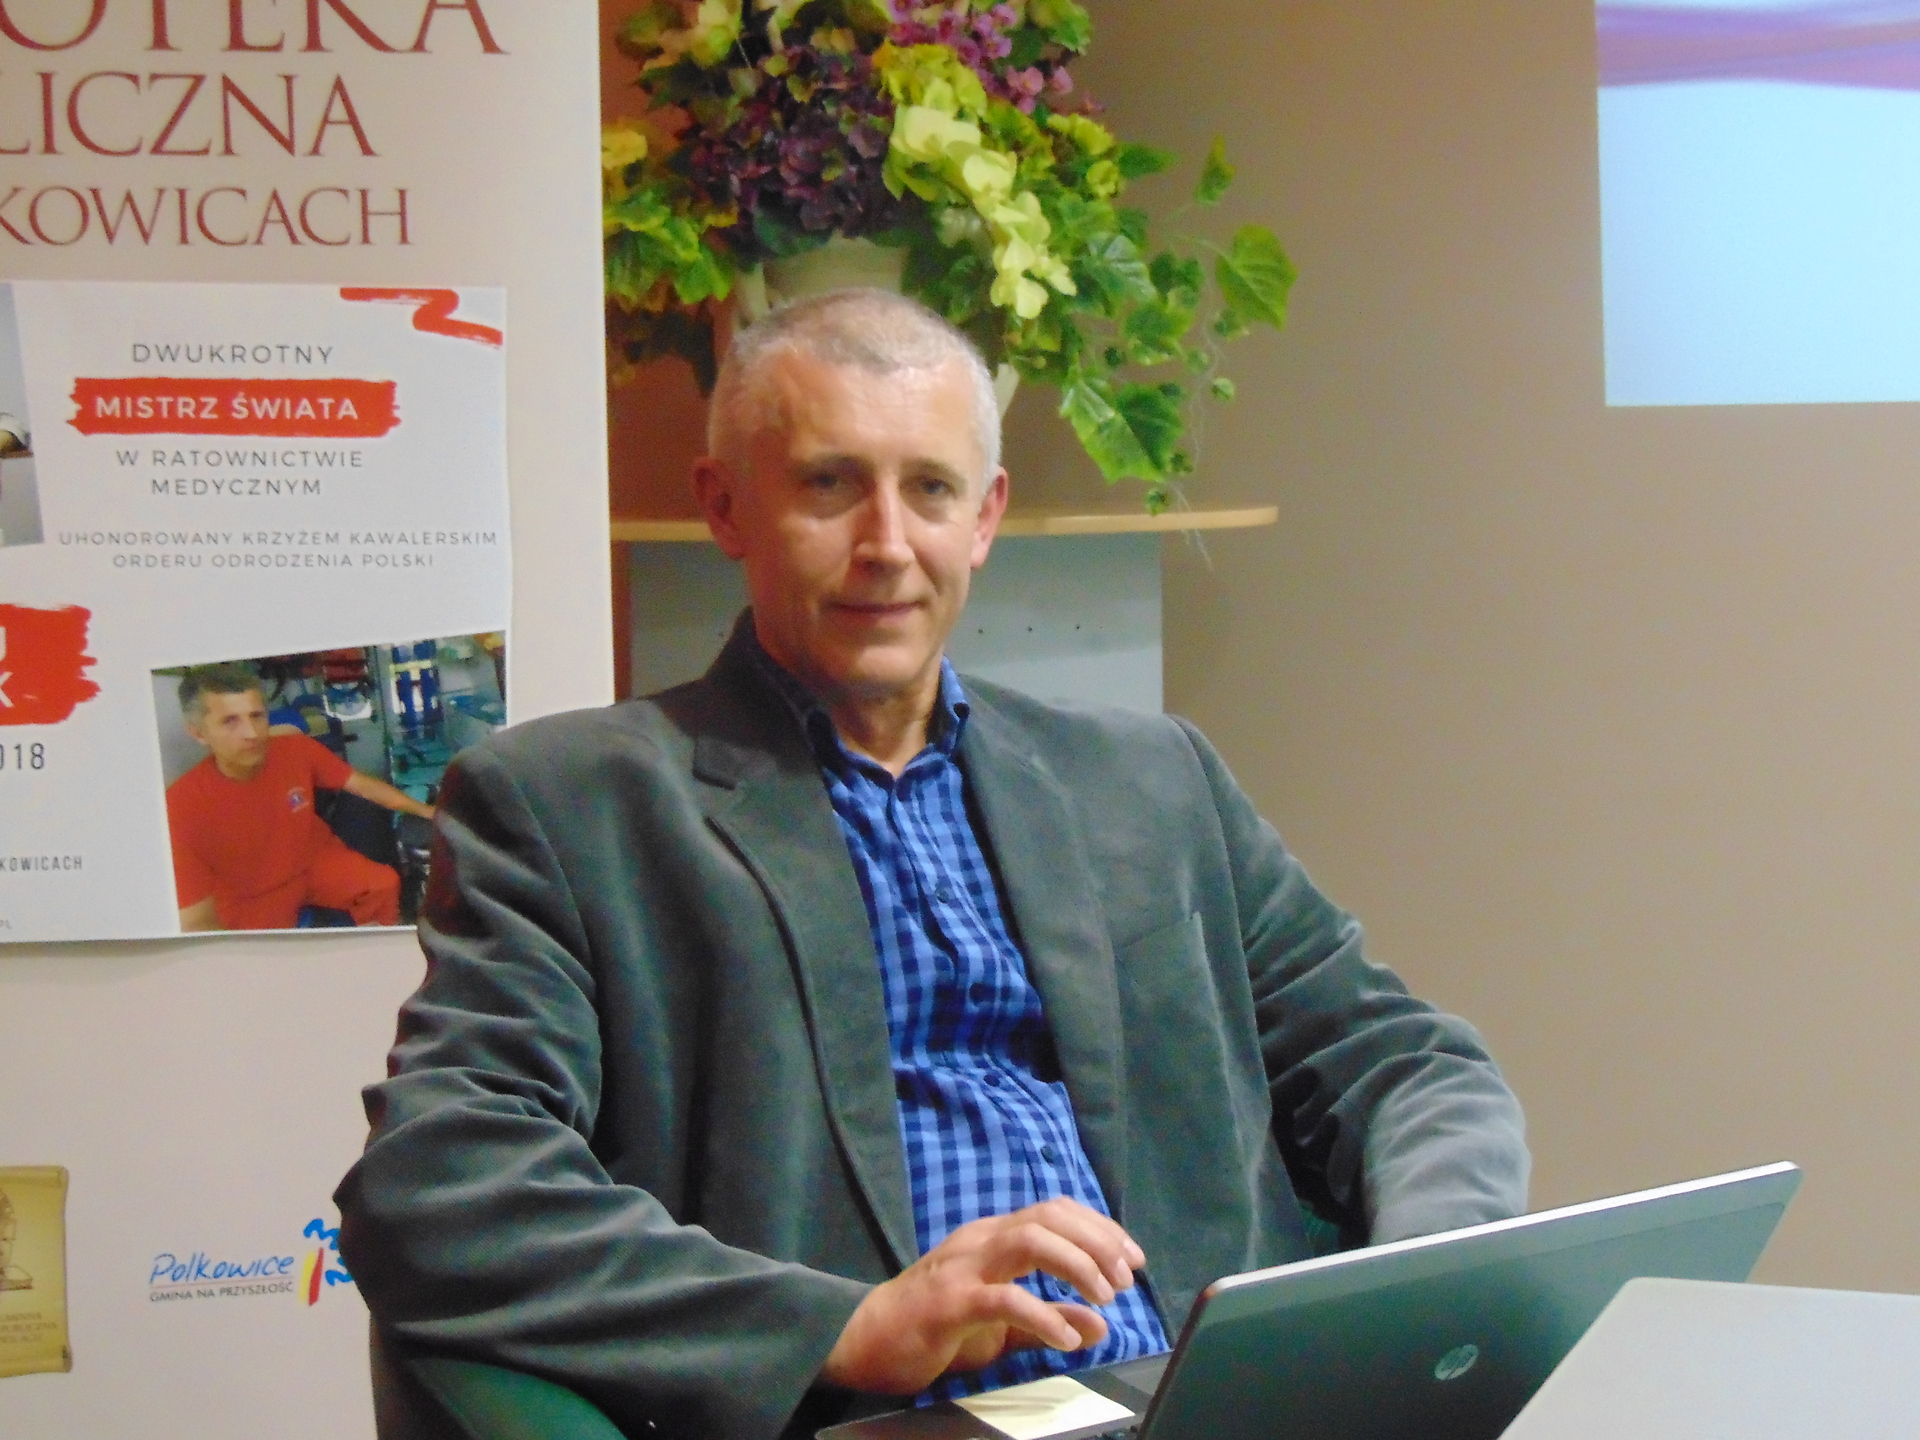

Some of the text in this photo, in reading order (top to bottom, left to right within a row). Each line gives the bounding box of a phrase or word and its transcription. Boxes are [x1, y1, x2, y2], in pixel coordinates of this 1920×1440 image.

[132, 344, 334, 364] DWUKROTNY
[95, 392, 359, 420] MISTRZ ŚWIATA
[116, 450, 364, 468] W RATOWNICTWIE
[151, 479, 322, 496] MEDYCZNYM
[58, 529, 497, 546] UHONOROWANY KRZYŻEM KAWALERSKIM
[112, 553, 434, 568] ORDERU ODRODZENIA POLSKI
[0, 742, 45, 770] 18
[150, 1252, 295, 1284] Polkowice
[150, 1290, 194, 1302] GMINA
[196, 1288, 215, 1299] NA
